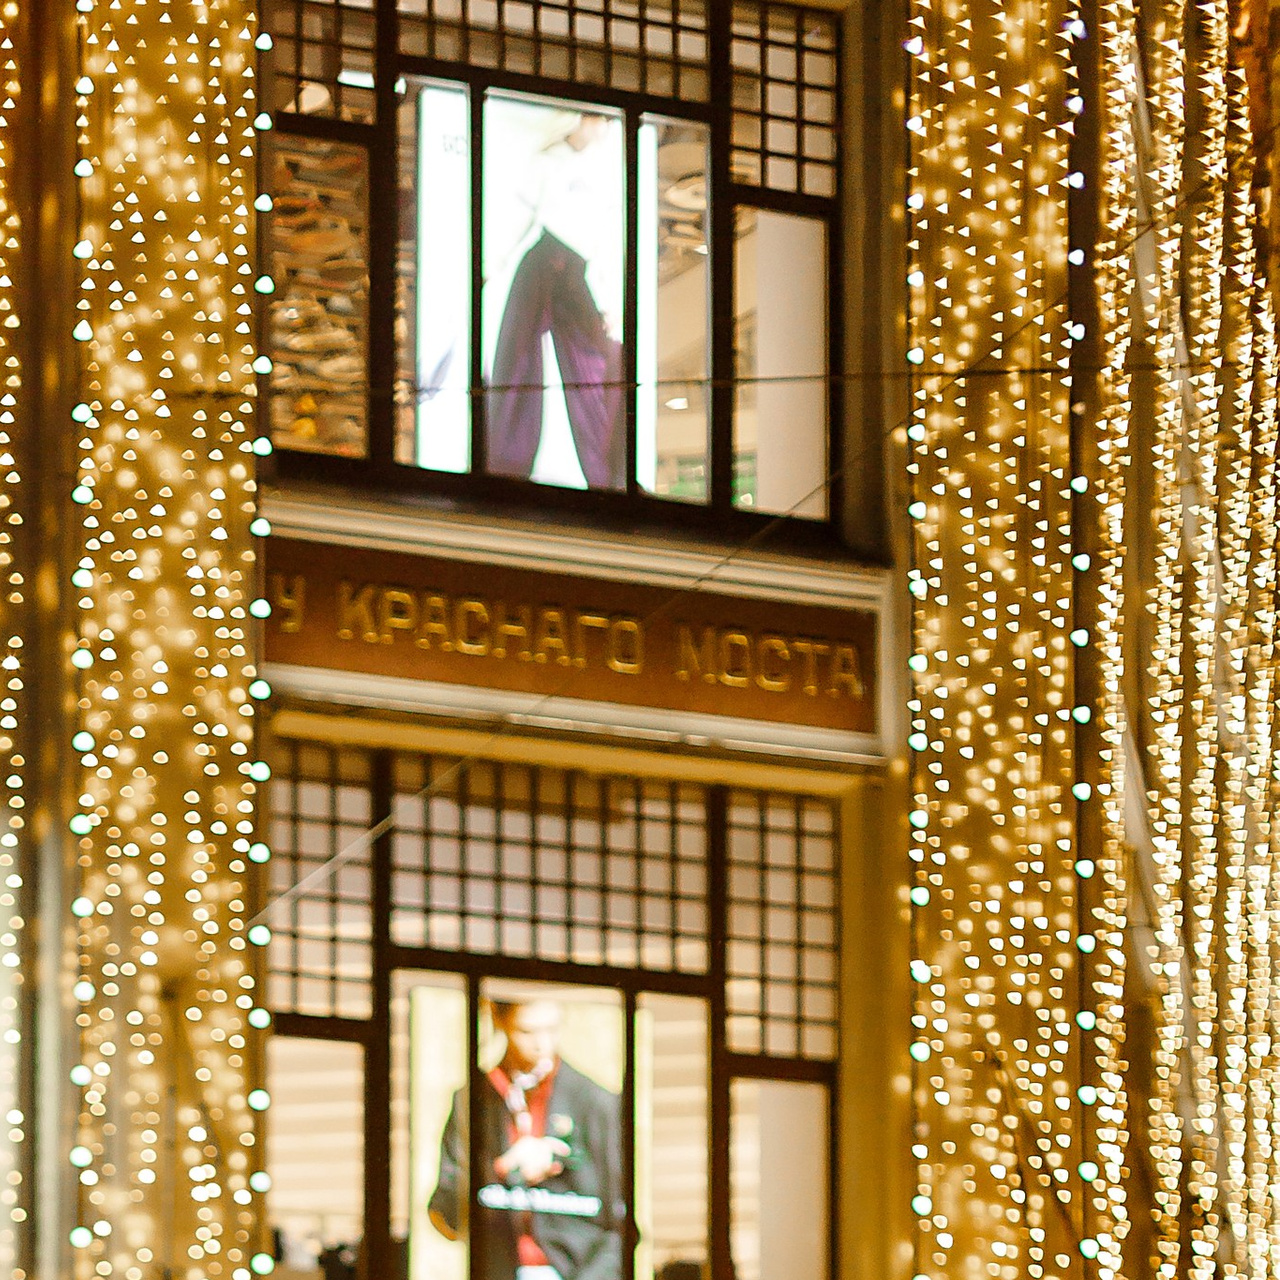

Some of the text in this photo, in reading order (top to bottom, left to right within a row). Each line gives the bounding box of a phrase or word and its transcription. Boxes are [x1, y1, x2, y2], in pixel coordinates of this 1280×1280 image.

[271, 574, 867, 701] У КРАСНАГО МОСТА
